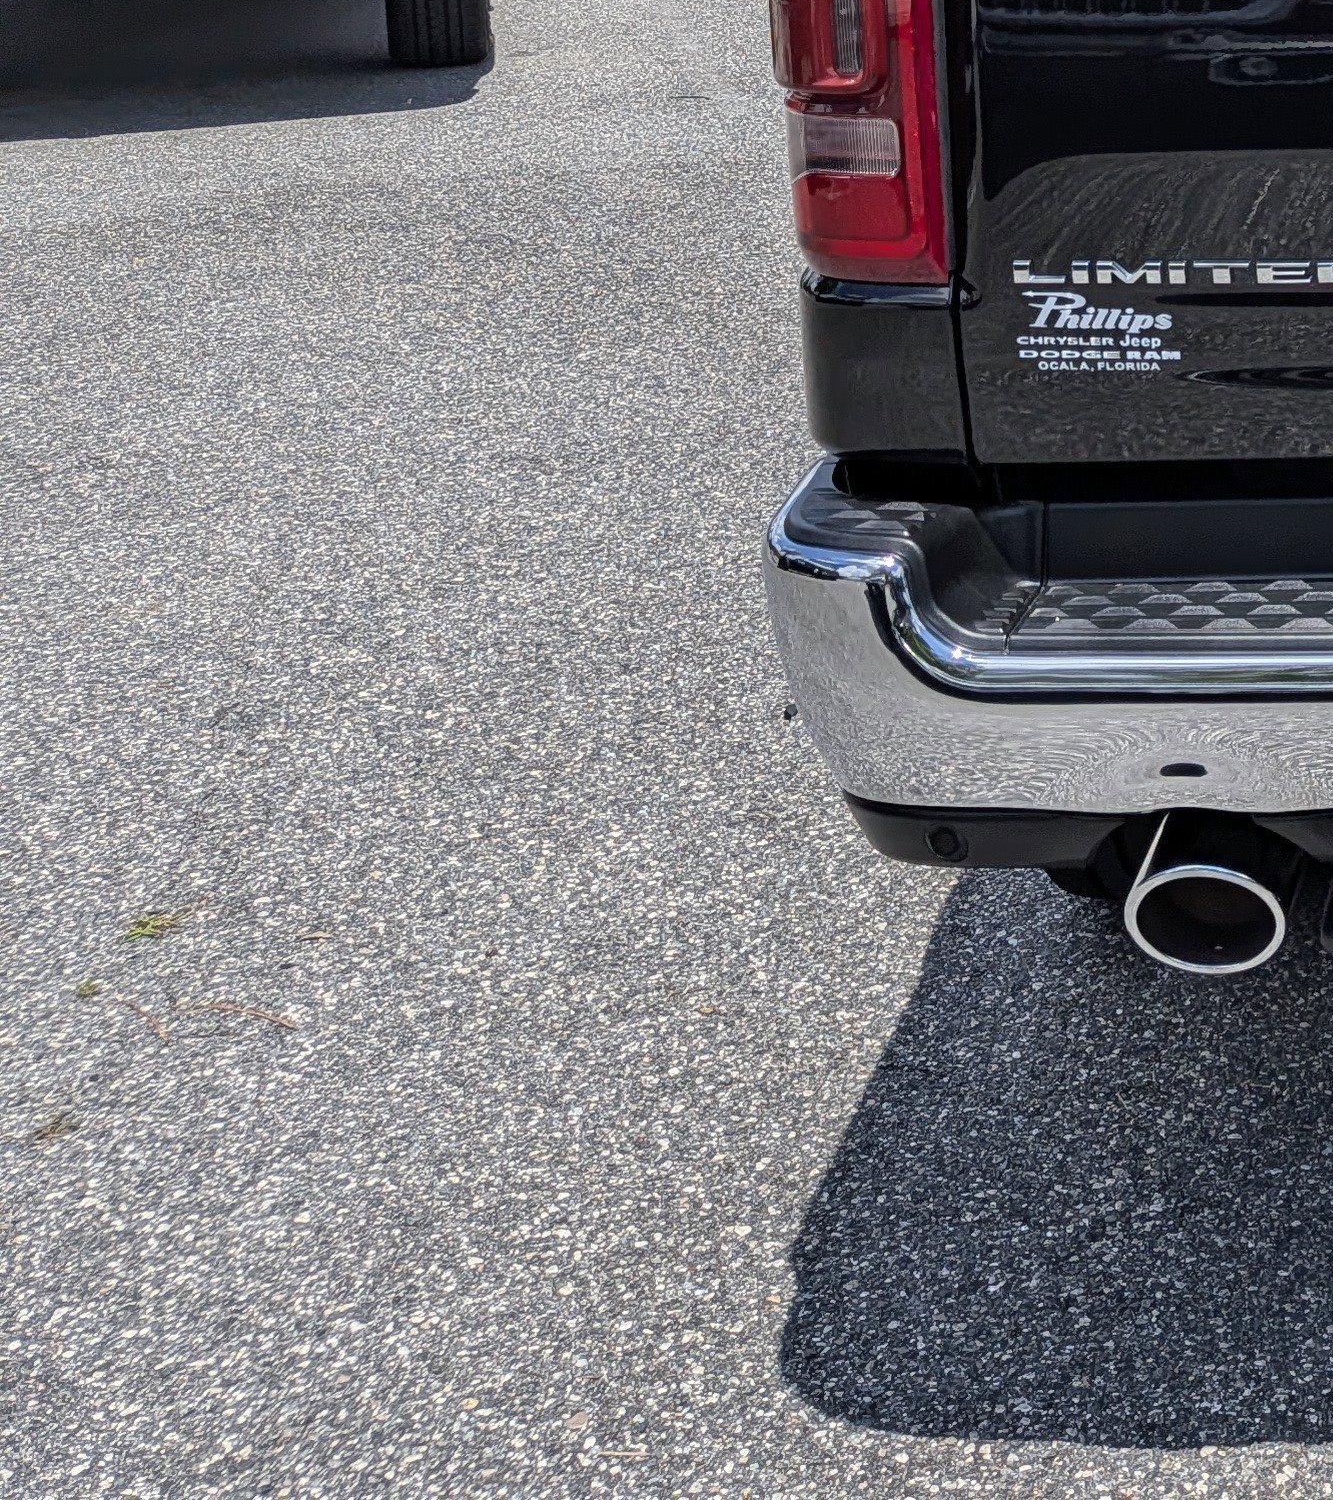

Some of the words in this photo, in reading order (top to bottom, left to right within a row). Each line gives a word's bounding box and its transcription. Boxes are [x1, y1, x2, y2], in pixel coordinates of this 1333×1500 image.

[1021, 290, 1173, 334] Phillips
[1016, 336, 1115, 346] CHRYSLER
[1119, 334, 1162, 349] Jeep
[1019, 350, 1121, 359] DODGE
[1126, 351, 1182, 360] RAM
[1038, 361, 1095, 372] OCALA,
[1097, 361, 1162, 371] FLORIDA
